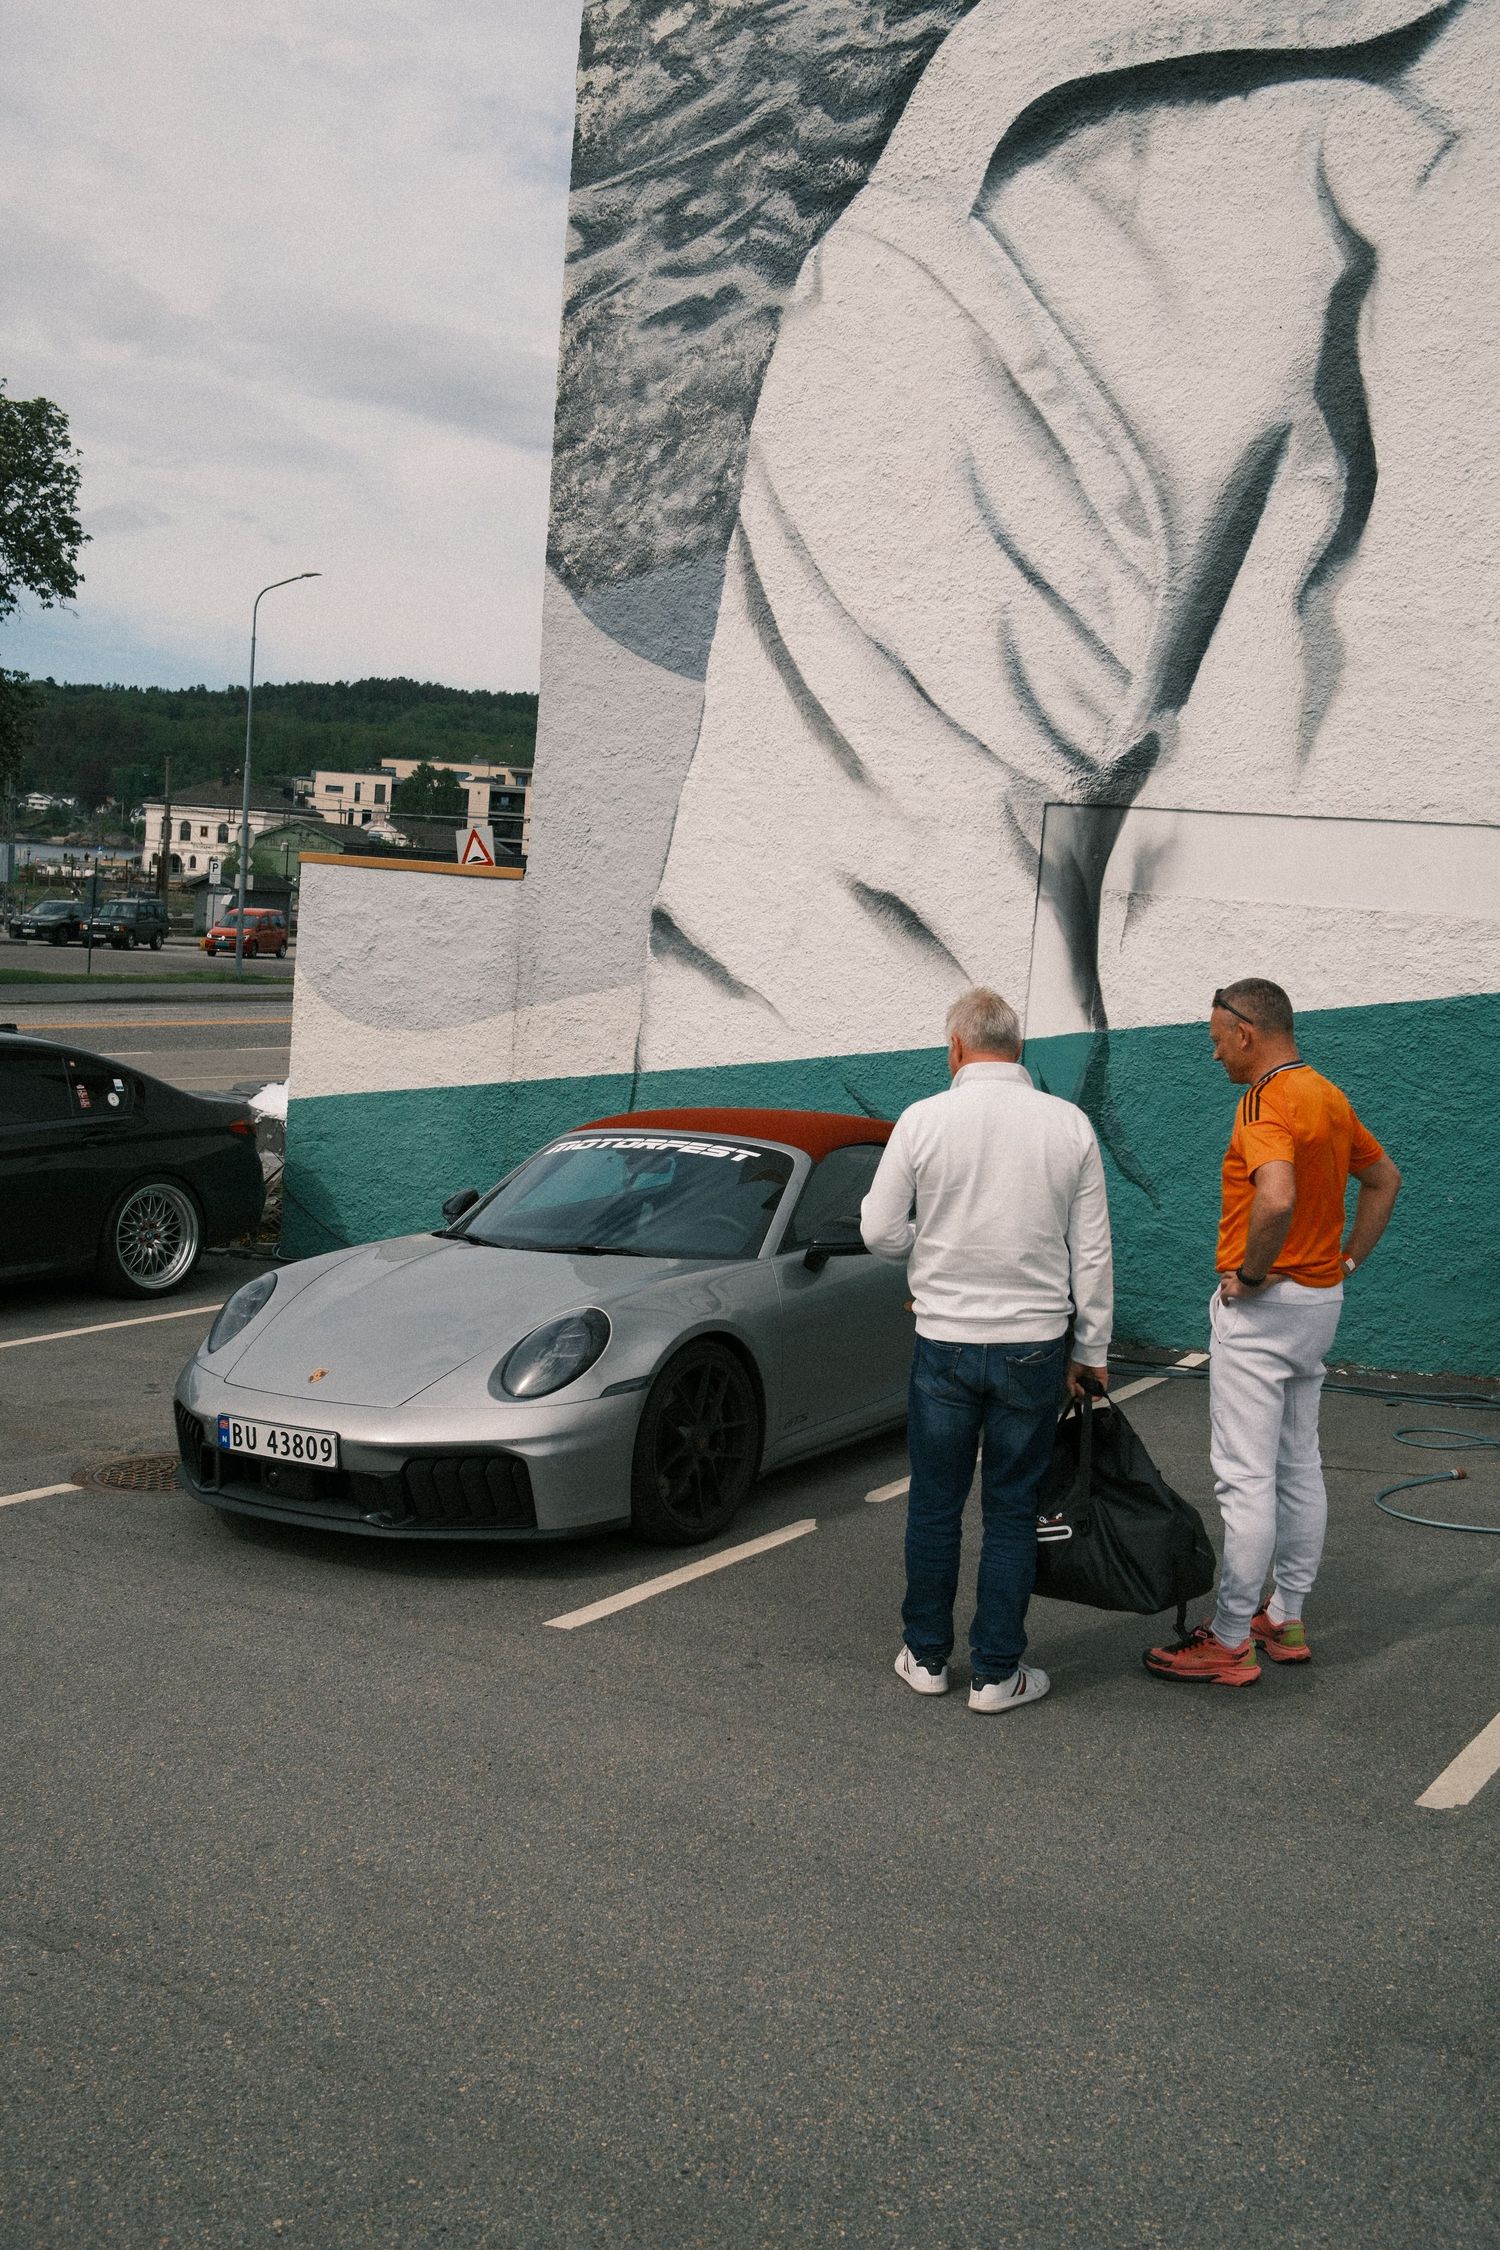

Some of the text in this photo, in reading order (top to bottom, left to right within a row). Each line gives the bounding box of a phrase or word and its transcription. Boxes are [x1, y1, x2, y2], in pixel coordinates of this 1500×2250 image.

[212, 863, 219, 872] P
[544, 1138, 762, 1162] MOTORFEST
[232, 1422, 332, 1463] BU 43809
